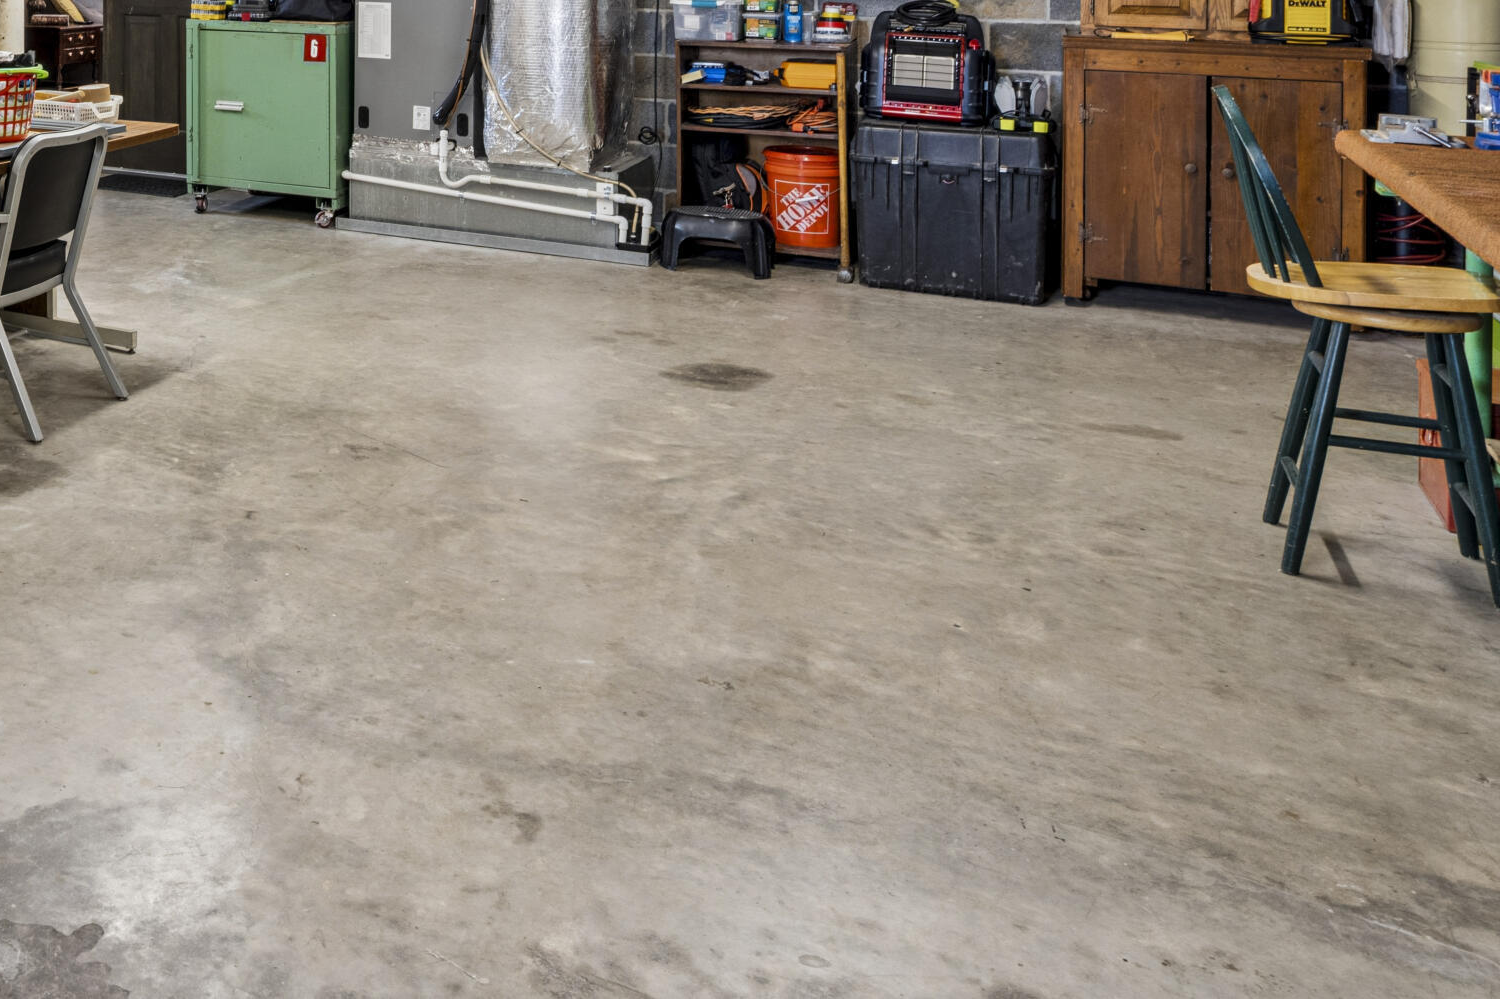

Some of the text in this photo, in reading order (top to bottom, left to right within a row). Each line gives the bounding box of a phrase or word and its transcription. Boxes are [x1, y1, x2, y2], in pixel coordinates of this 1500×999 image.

[310, 39, 319, 58] 6
[776, 184, 829, 231] HOME
[780, 187, 803, 207] THE
[795, 202, 829, 233] DEPOT
